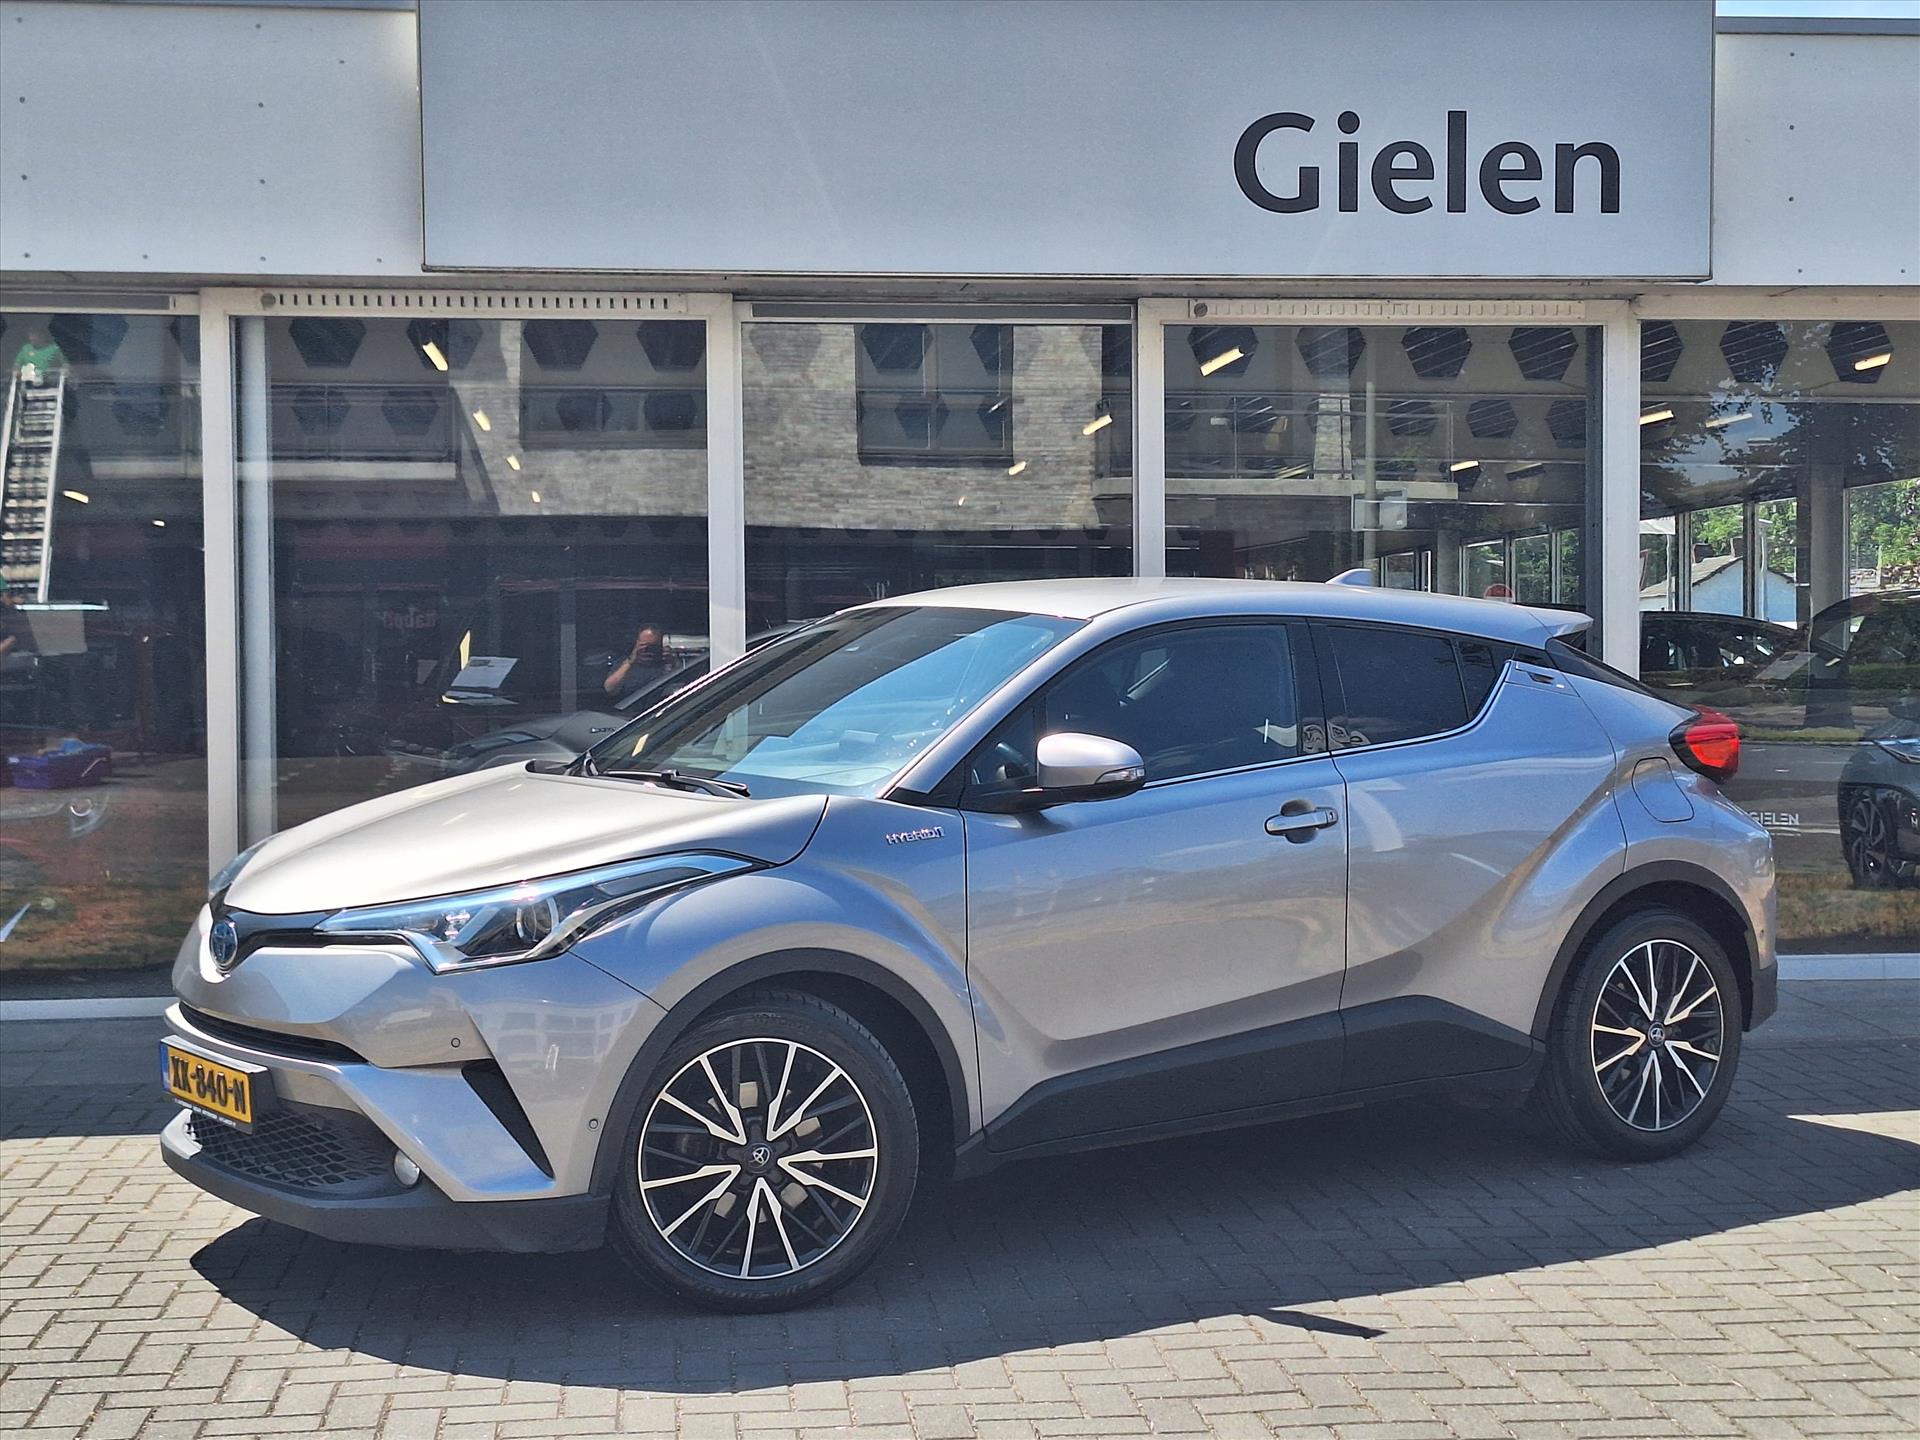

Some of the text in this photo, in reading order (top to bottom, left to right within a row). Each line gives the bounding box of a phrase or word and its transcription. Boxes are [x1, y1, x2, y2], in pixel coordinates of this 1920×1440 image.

[1233, 110, 1620, 214] Gielen
[885, 826, 945, 846] HYBRID
[170, 1055, 246, 1115] XK-840-N
